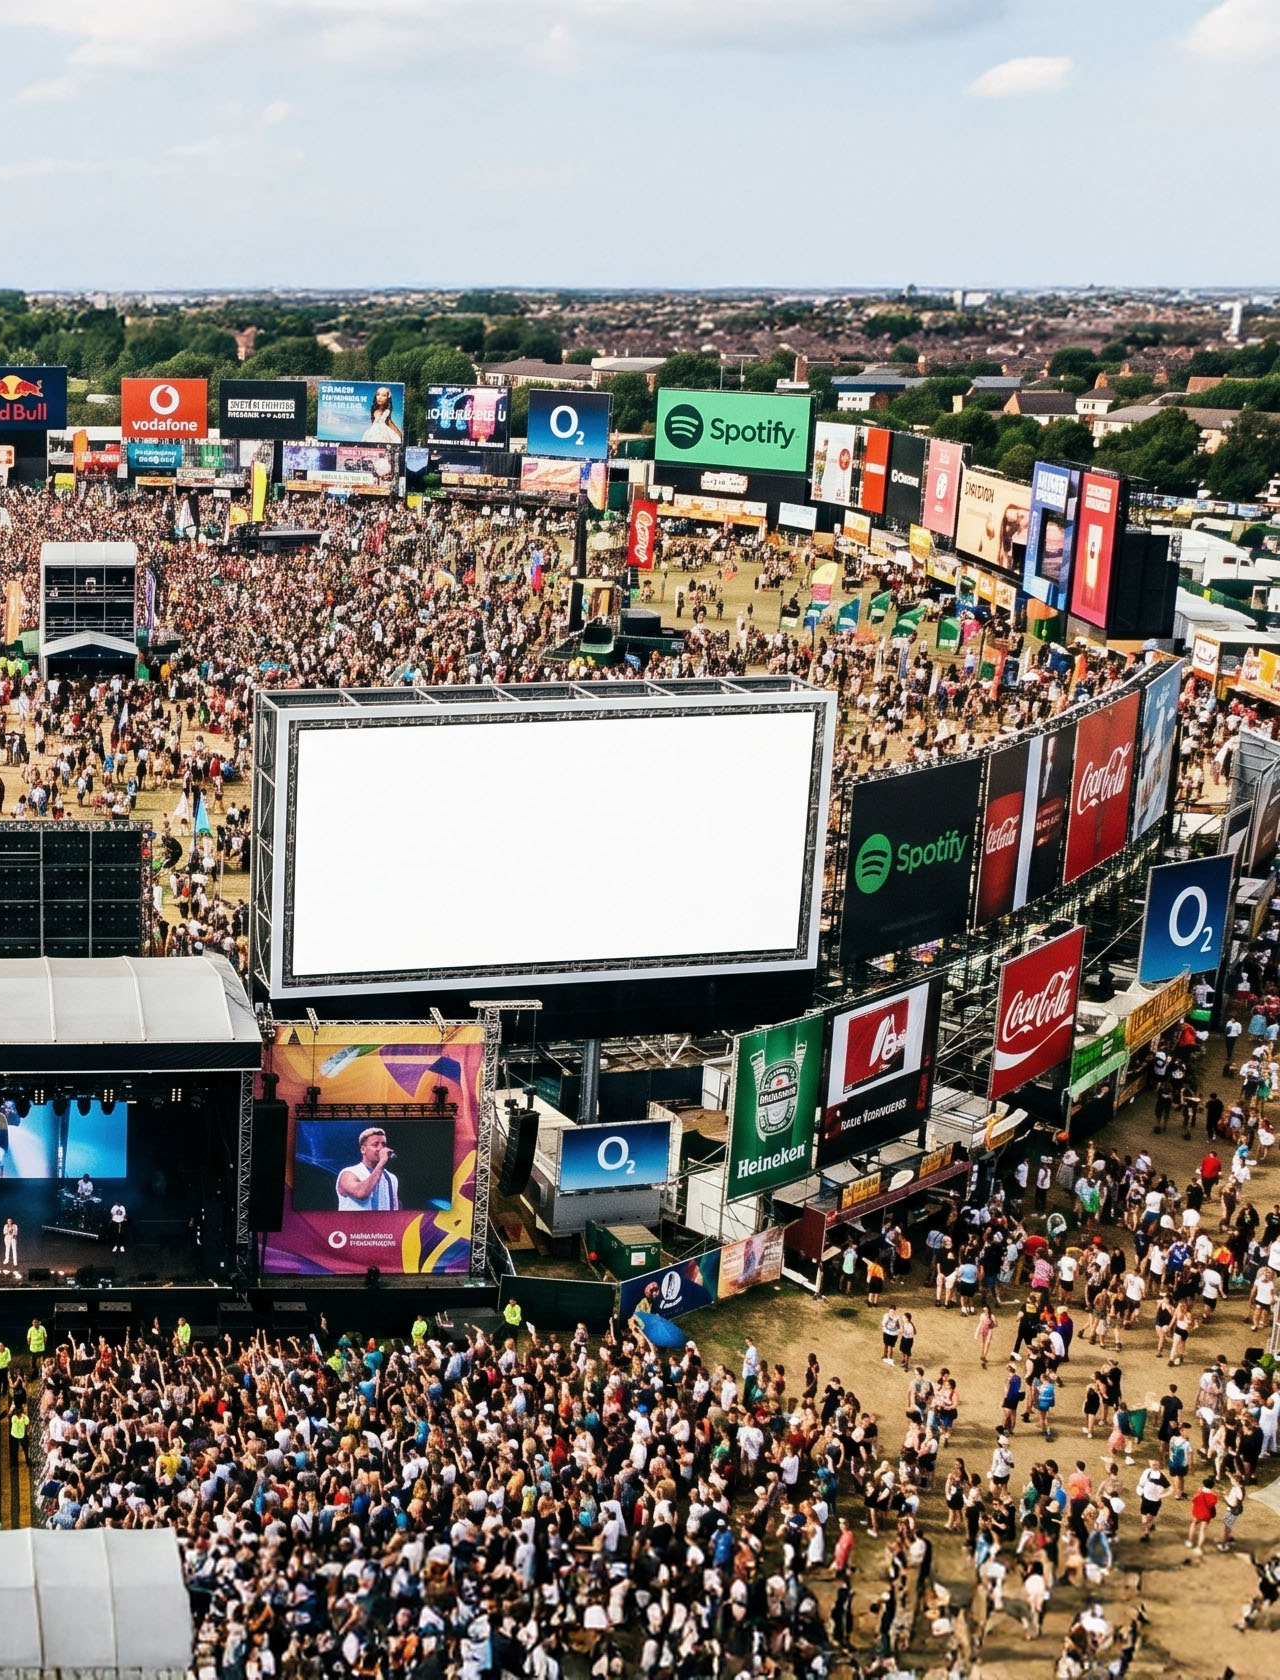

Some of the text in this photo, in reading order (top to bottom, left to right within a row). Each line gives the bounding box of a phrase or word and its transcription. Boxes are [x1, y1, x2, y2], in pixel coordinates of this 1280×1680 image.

[14, 403, 47, 421] Bull
[132, 418, 198, 432] vodafone
[710, 417, 796, 449] Spotify
[896, 829, 968, 875] Spotify
[737, 1143, 806, 1180] Heineken
